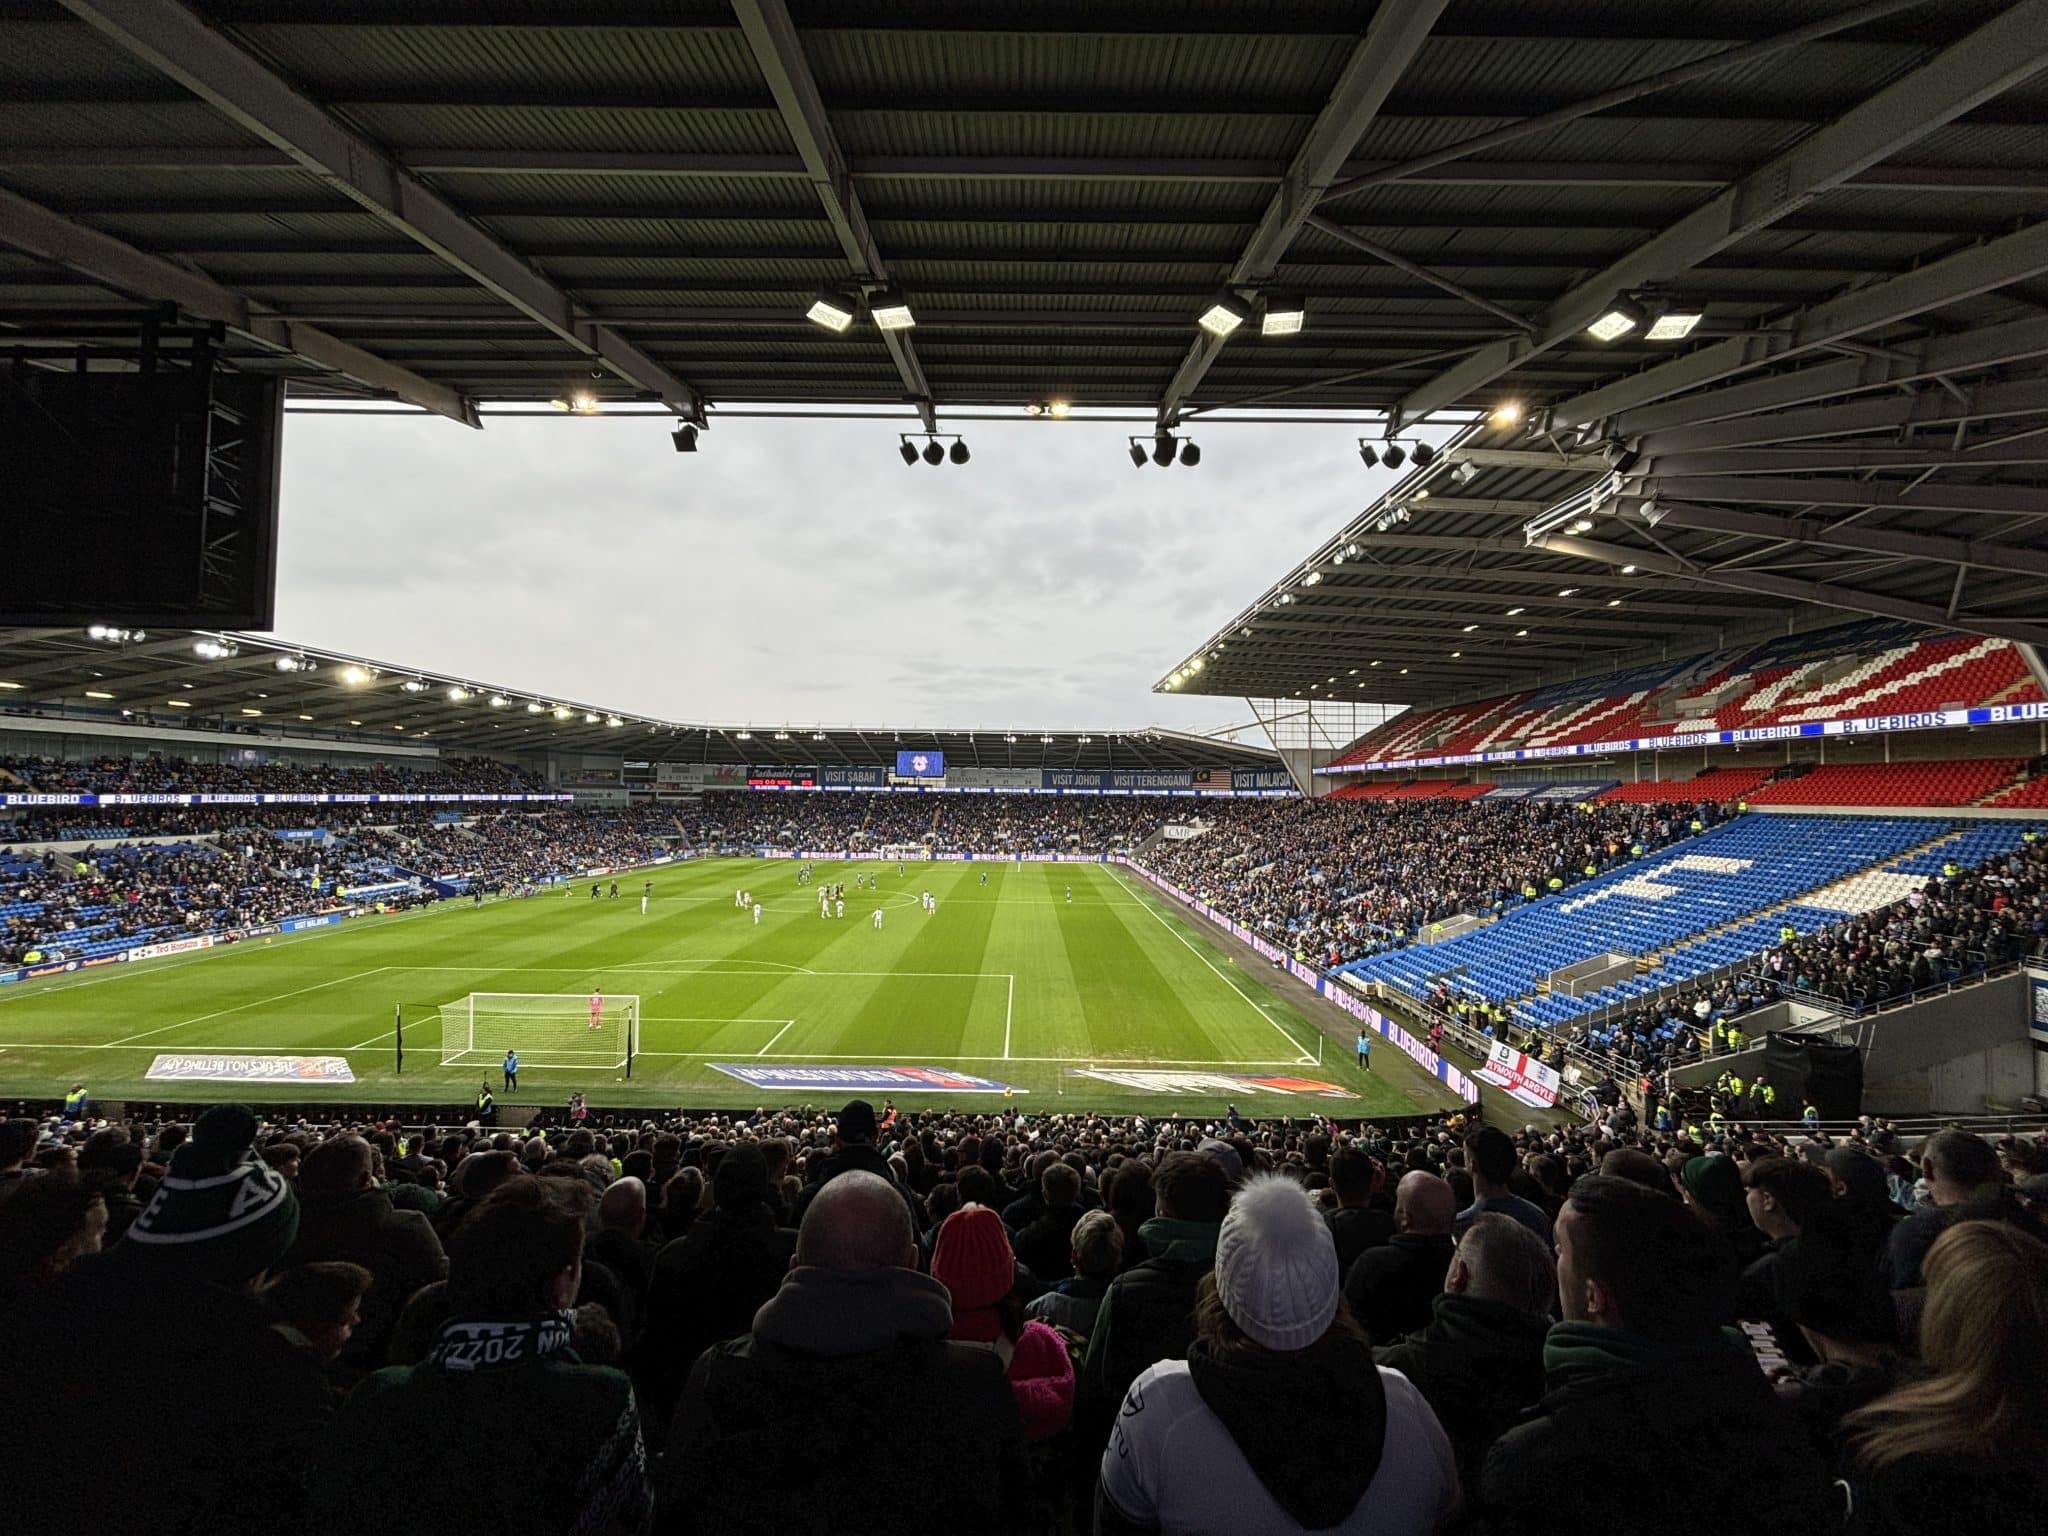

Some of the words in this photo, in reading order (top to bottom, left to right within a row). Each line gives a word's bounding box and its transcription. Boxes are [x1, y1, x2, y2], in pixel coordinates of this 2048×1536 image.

[1733, 725, 1800, 742] BLUEBIRD
[1649, 734, 1707, 748] BLUEBIRDS
[825, 771, 845, 782] VISIT
[847, 771, 876, 783] SABAH
[1052, 774, 1074, 785] VISIT
[1075, 774, 1100, 786] JOHOR
[1114, 775, 1135, 786] VISIT
[1137, 775, 1190, 787] TERENGGANU
[1234, 773, 1255, 787] VISIT
[1256, 772, 1291, 787] MALAYSIA
[7, 794, 80, 805] BLUEBIRD
[156, 943, 169, 953] Ted
[1388, 1020, 1439, 1077] BLUEBIRDS
[1486, 1060, 1524, 1085] PLYMOUTH
[1523, 1080, 1555, 1101] ARGYLE
